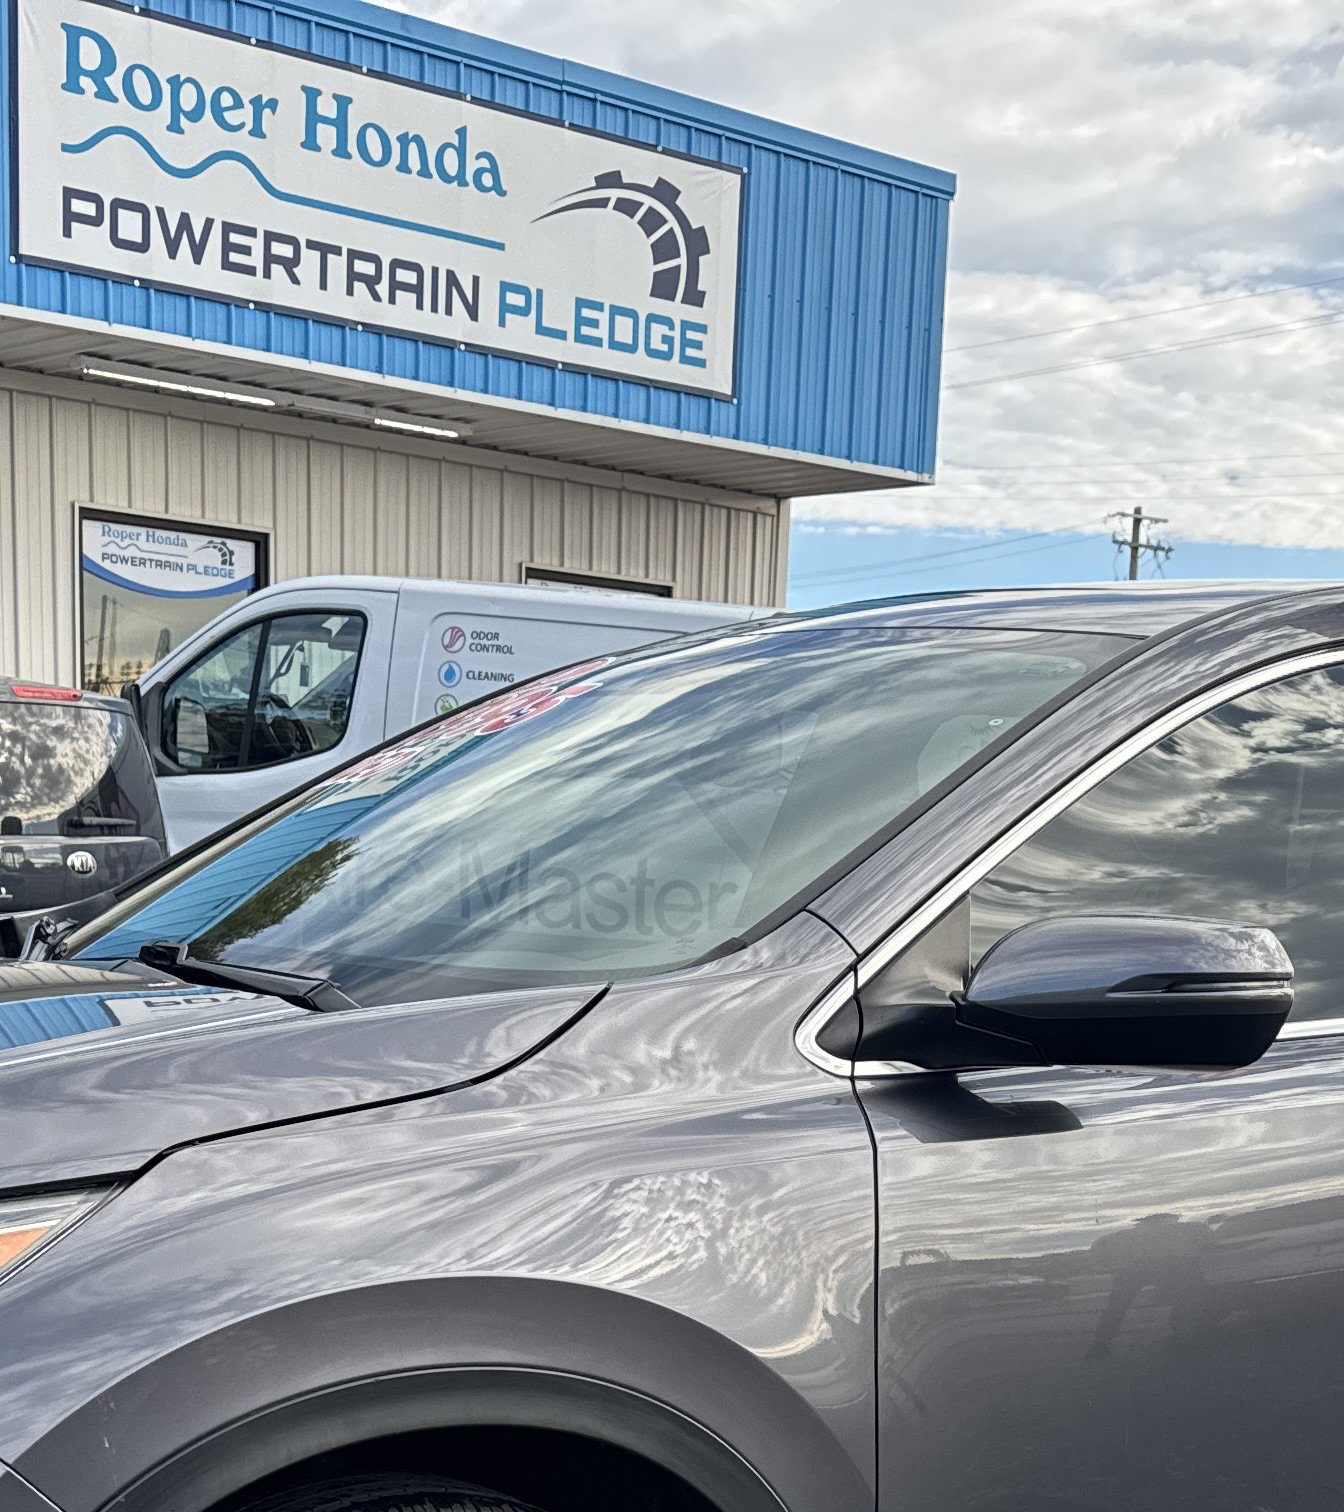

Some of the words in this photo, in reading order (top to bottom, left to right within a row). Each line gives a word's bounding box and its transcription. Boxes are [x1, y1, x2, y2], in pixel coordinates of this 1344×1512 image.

[60, 22, 278, 139] Roper
[300, 84, 507, 197] Honda
[62, 186, 480, 322] POWERTRAIN
[499, 283, 707, 368] PLEDGE
[101, 524, 141, 542] Roper
[145, 530, 188, 548] Honda
[101, 552, 183, 573] POWERTRAIN
[186, 563, 235, 579] PLEDGE
[470, 630, 500, 641] ODOR
[469, 642, 515, 655] CONTROL
[466, 670, 515, 683] CLEANING
[71, 853, 94, 875] KIA
